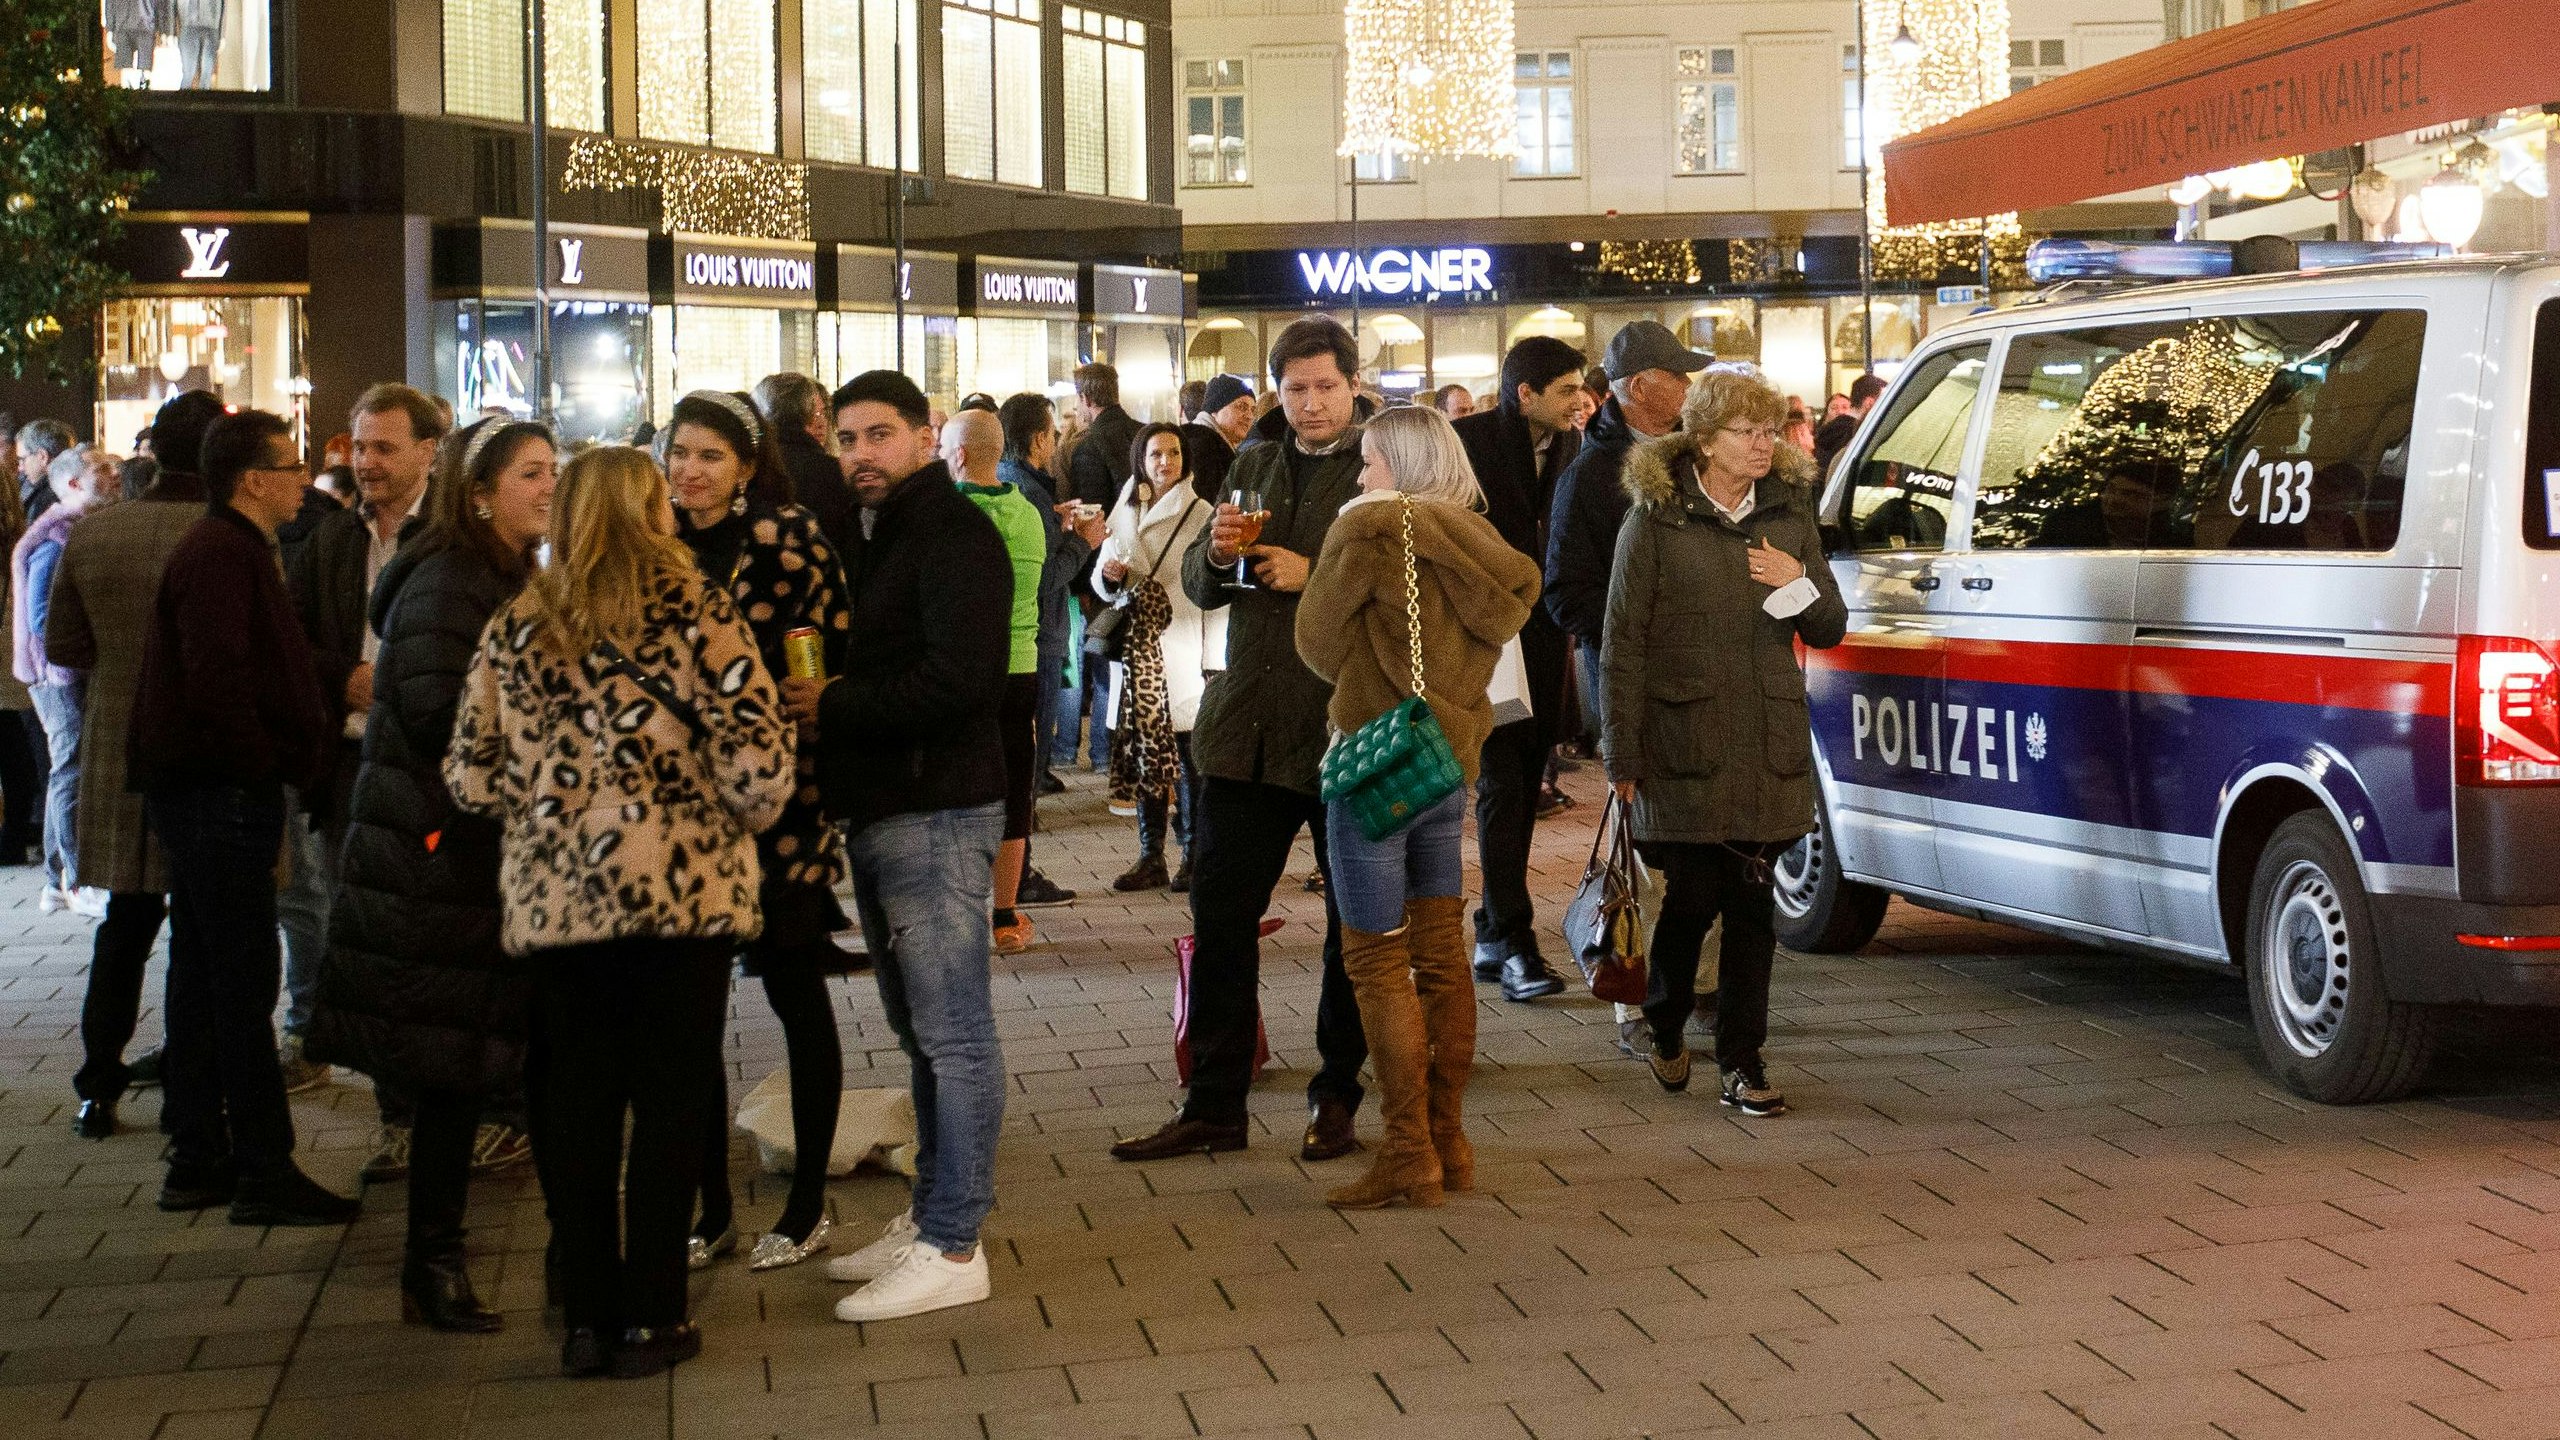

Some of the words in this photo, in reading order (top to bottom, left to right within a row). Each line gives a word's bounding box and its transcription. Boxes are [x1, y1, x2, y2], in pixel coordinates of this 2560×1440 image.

[2101, 116, 2148, 175] ZUM
[2155, 74, 2308, 164] SCHWARZEN
[2318, 43, 2429, 126] KAMEEL
[686, 253, 737, 287] LOUIS
[740, 256, 811, 290] VUITTON
[984, 272, 1022, 303] LOUIS
[1023, 275, 1076, 304] VUITTON
[1298, 248, 1493, 295] WAGNER
[2259, 460, 2314, 524] 133
[1852, 693, 2019, 783] POLIZEI
